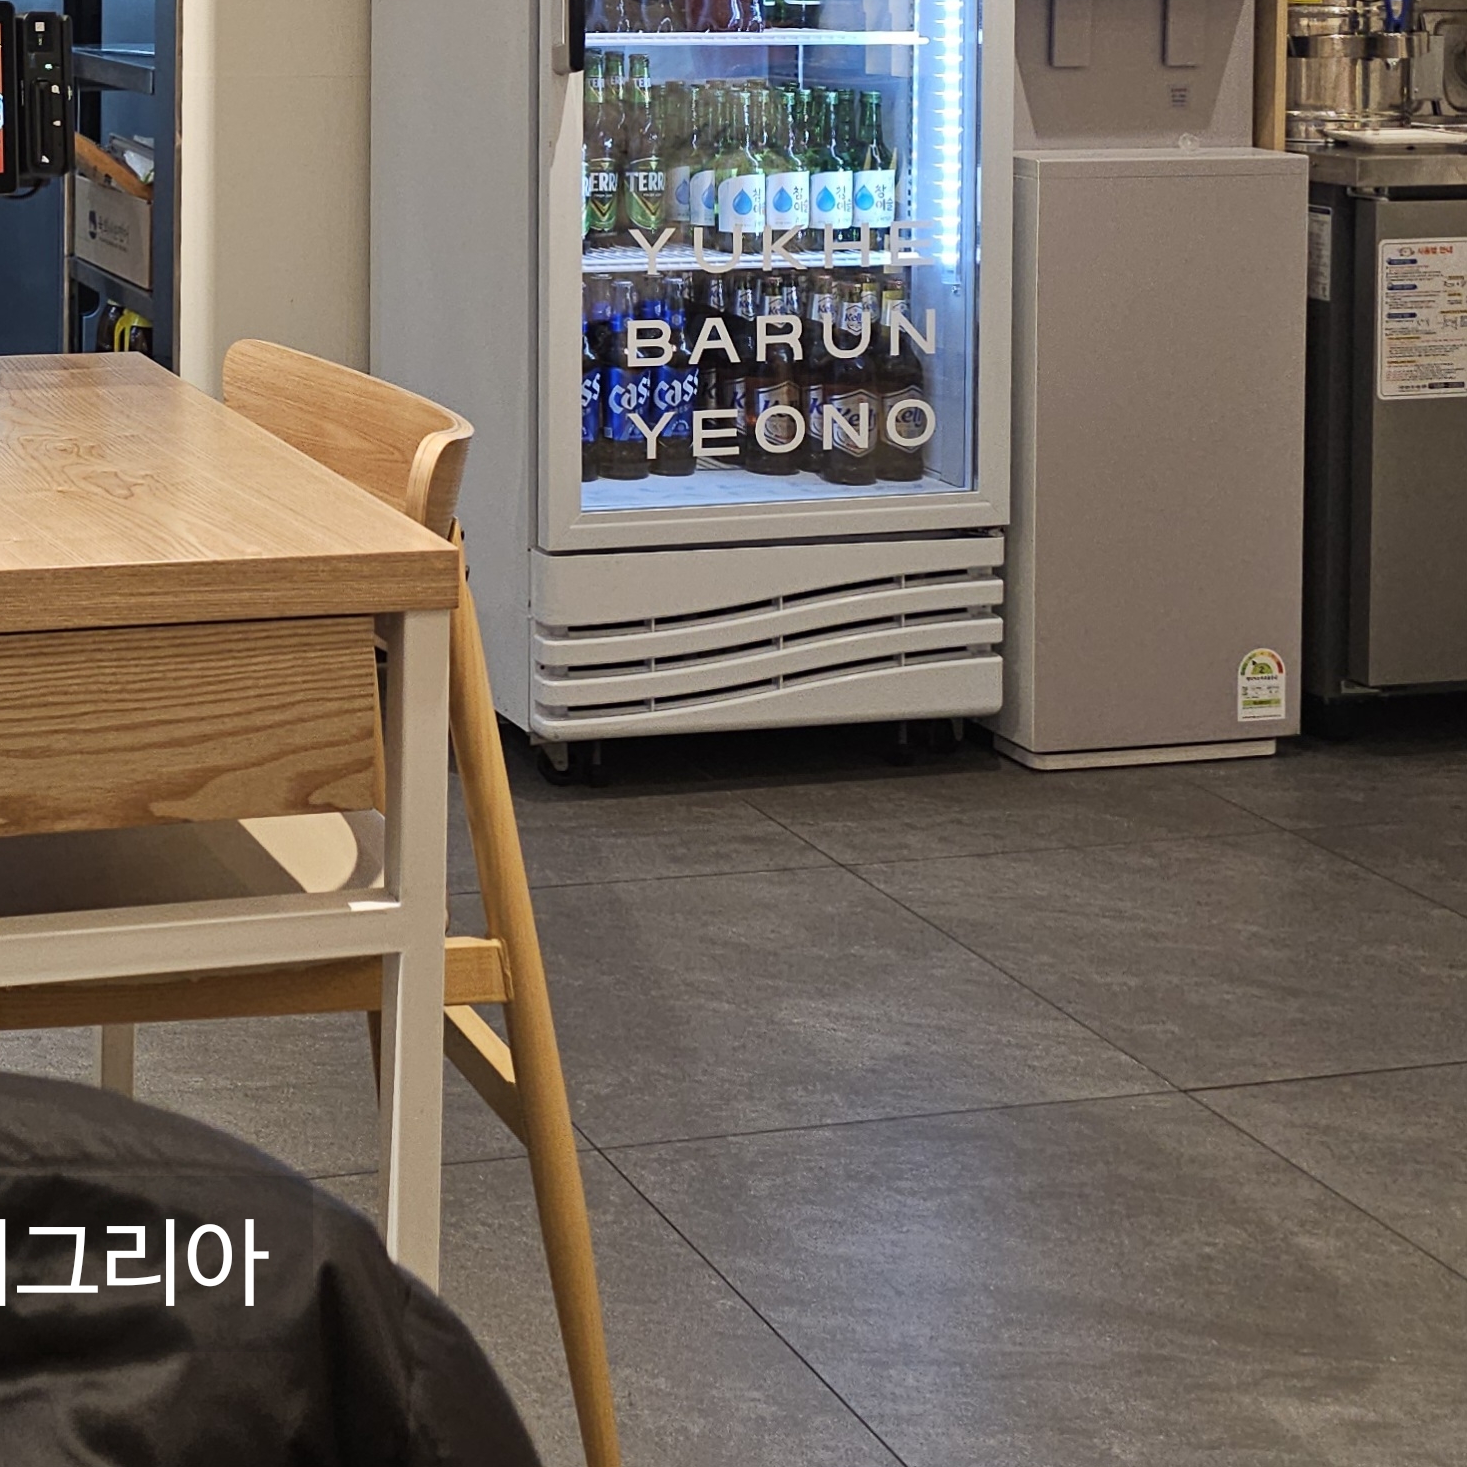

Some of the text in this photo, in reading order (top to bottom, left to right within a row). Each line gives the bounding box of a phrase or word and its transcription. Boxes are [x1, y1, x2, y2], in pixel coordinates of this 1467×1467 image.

[628, 221, 934, 275] YUKHE
[626, 308, 936, 367] BARUN
[627, 399, 936, 460] YEONO
